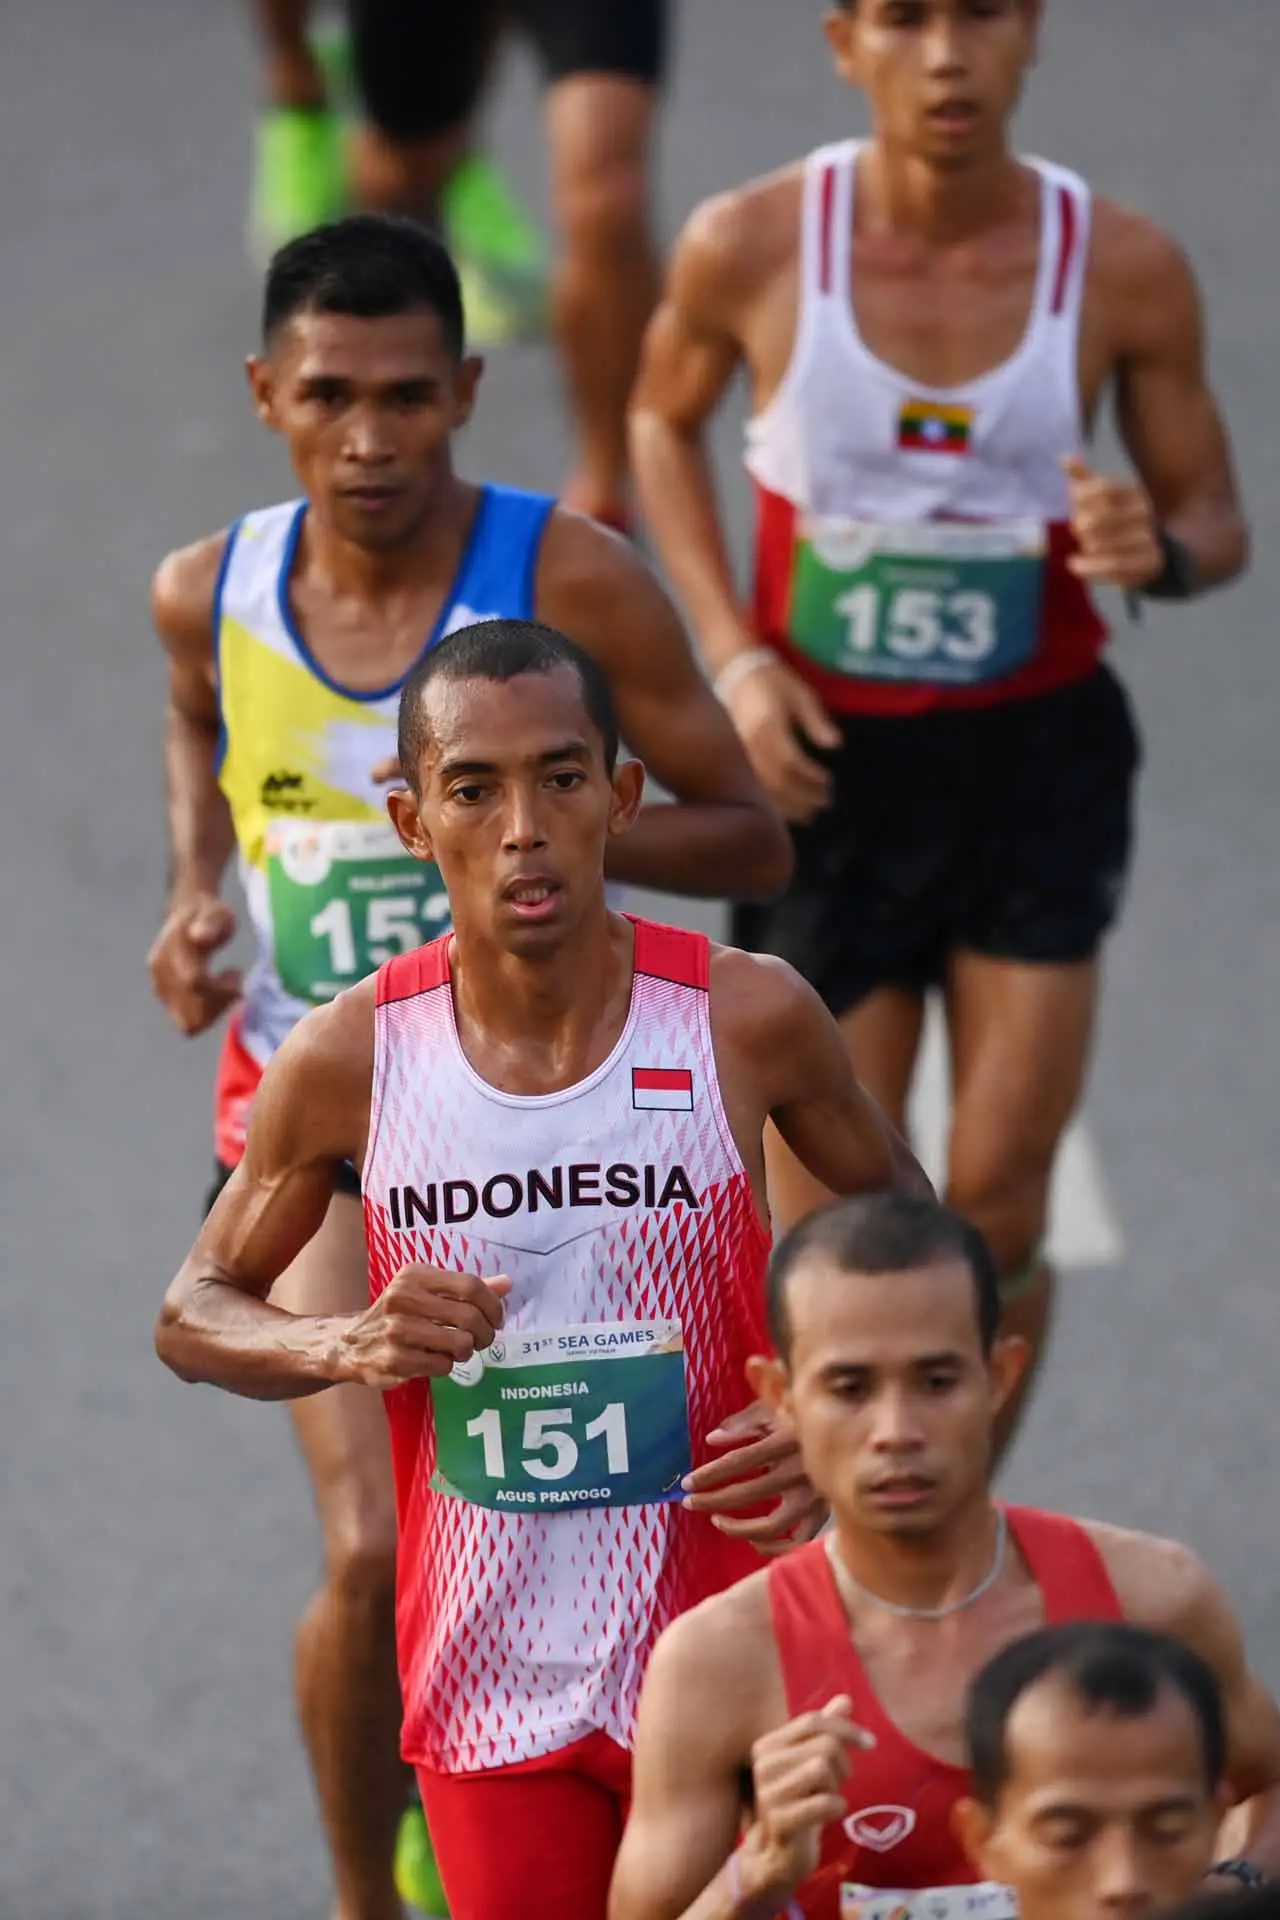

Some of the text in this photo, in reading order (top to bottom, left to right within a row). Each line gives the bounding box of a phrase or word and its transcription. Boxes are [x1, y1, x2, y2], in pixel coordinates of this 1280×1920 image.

[834, 583, 996, 661] 153
[388, 1163, 699, 1229] INDONESIA
[558, 1335, 590, 1349] SEA
[593, 1329, 655, 1346] GAMES
[501, 1381, 589, 1400] INDONESIA
[466, 1402, 630, 1481] 151
[495, 1487, 612, 1504] AGUS PRAYOGO
